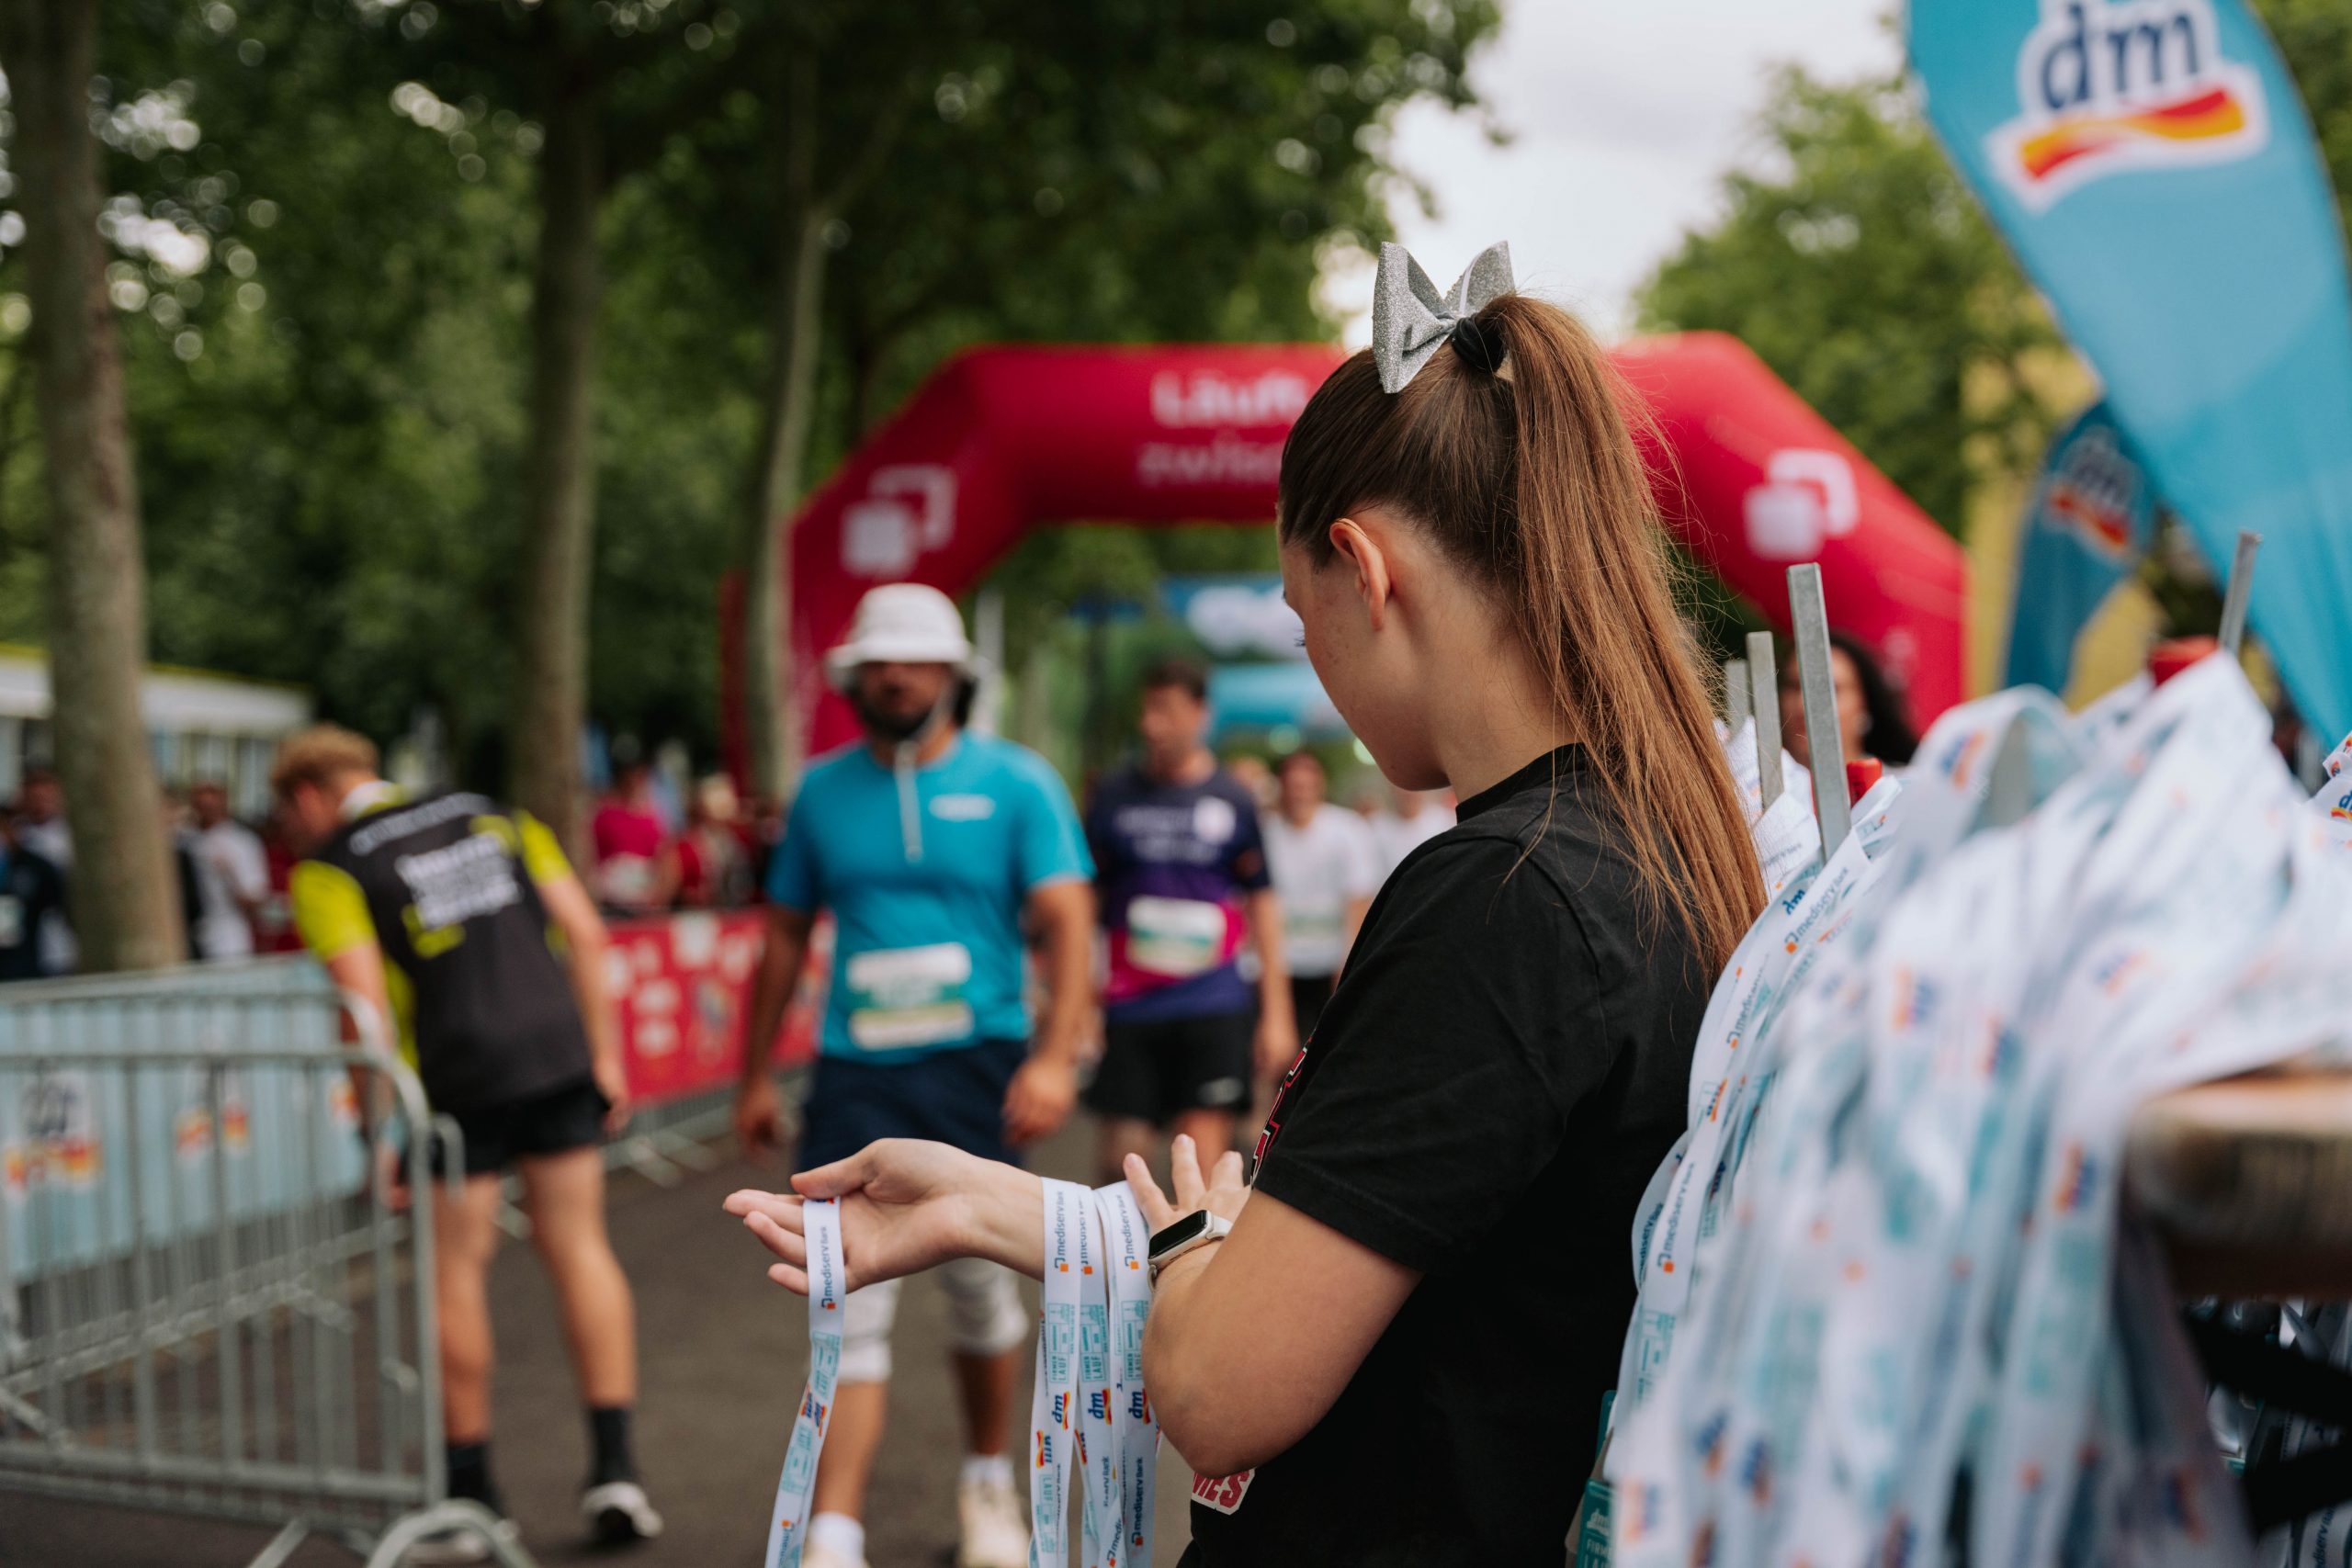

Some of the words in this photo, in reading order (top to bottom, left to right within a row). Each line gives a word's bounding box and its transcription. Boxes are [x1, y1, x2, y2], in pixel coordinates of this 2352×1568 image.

[2039, 0, 2200, 109] dm
[1055, 1207, 1066, 1257] mediserv
[820, 1246, 833, 1297] mediserv
[1052, 1394, 1063, 1424] dm
[1088, 1392, 1104, 1419] dm
[1128, 1391, 1144, 1419] dm
[1133, 1479, 1144, 1531] mediserv
